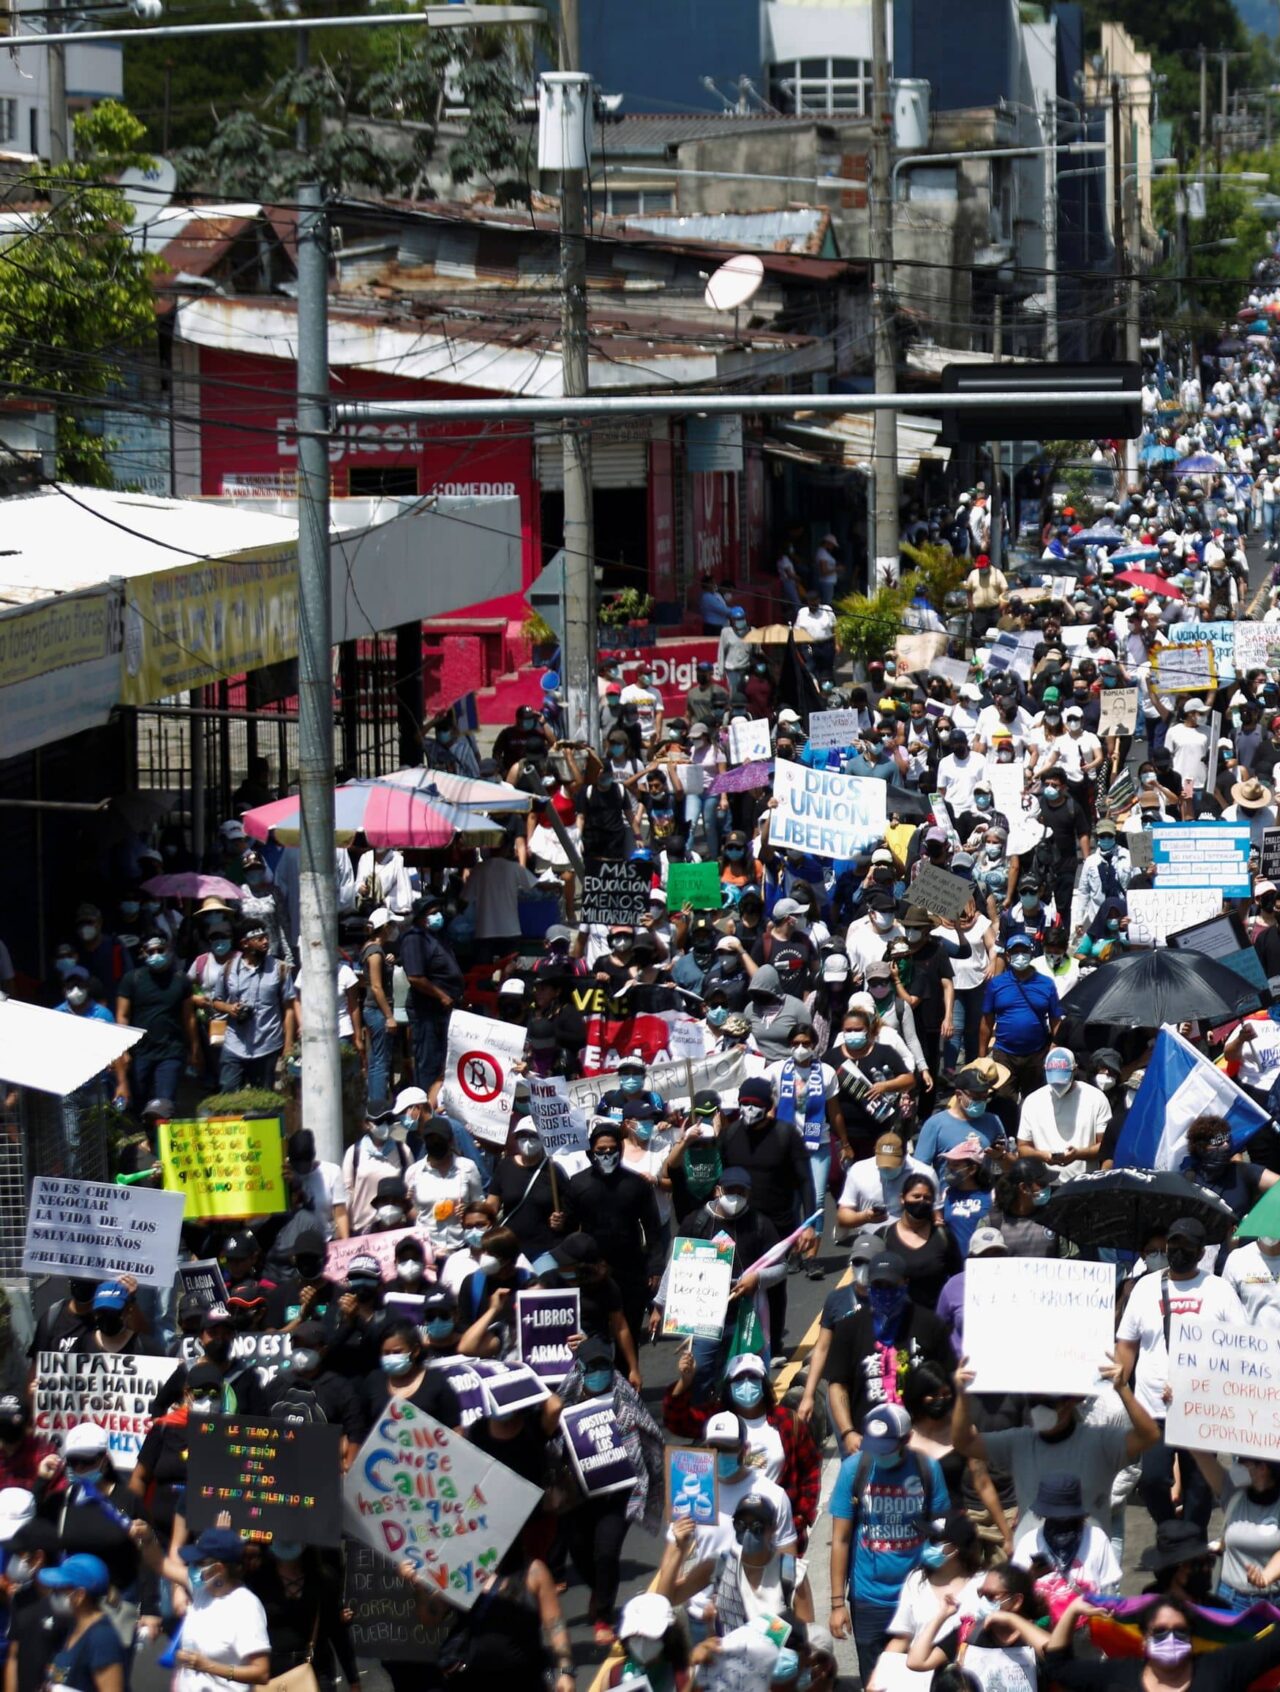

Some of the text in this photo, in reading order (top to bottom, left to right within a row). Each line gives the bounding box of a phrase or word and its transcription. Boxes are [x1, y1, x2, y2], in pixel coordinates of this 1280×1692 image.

[805, 769, 863, 800] DIOS
[790, 788, 869, 825] UNION
[583, 894, 644, 910] MENOS
[40, 1181, 130, 1200] NO ES CHIVO
[38, 1195, 109, 1211] NEGOCIAR
[35, 1209, 157, 1233] LA VIDA DE LOS
[32, 1229, 142, 1250] SALVADOREÑOS
[30, 1250, 155, 1276] #BUKELEMARERO
[523, 1308, 575, 1328] +LIBROS
[1179, 1323, 1202, 1342] NO
[1212, 1328, 1268, 1352] QUIERO
[40, 1353, 138, 1375] UN PAIS
[1178, 1353, 1197, 1367] EN
[1209, 1357, 1229, 1372] UN
[1241, 1360, 1272, 1379] PAÍS
[1191, 1379, 1210, 1393] DE
[79, 1392, 126, 1412] FOSA
[1184, 1401, 1235, 1420] DEUDAS
[1250, 1411, 1258, 1425] Y
[201, 1423, 215, 1434] NO
[228, 1425, 239, 1435] LE
[246, 1427, 269, 1438] TEMO
[284, 1429, 295, 1439] LA
[379, 1418, 449, 1448] Calle
[229, 1444, 276, 1458] REPRESIÓN
[597, 1437, 614, 1452] LOS
[247, 1460, 264, 1470] DEL
[365, 1448, 458, 1498] Calla
[202, 1486, 315, 1505] LE TEMO AL SILENCIO DE
[251, 1506, 262, 1517] MI
[884, 1513, 903, 1525] FOR
[240, 1529, 273, 1541] PUEBLO
[381, 1513, 488, 1552] Dictador
